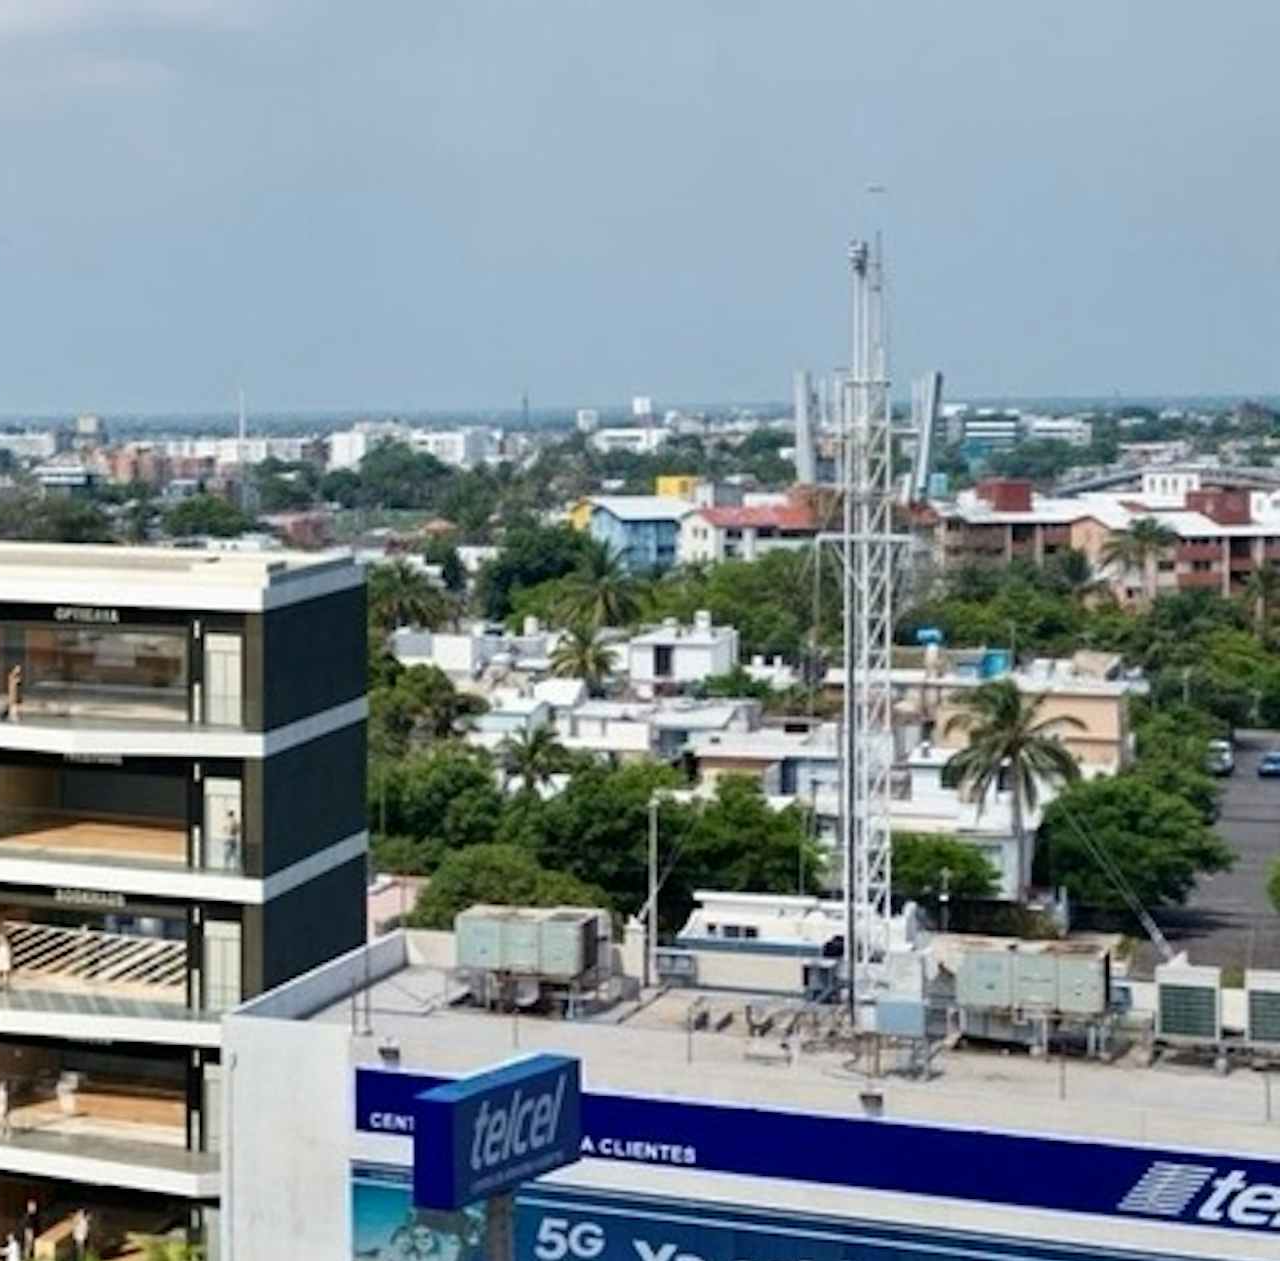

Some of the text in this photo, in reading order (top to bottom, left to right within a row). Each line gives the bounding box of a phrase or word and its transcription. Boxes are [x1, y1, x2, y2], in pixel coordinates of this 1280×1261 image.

[469, 1073, 567, 1171] telcel
[599, 1137, 697, 1165] CLIENTES
[1197, 1169, 1280, 1229] te
[533, 1216, 606, 1261] 5G
